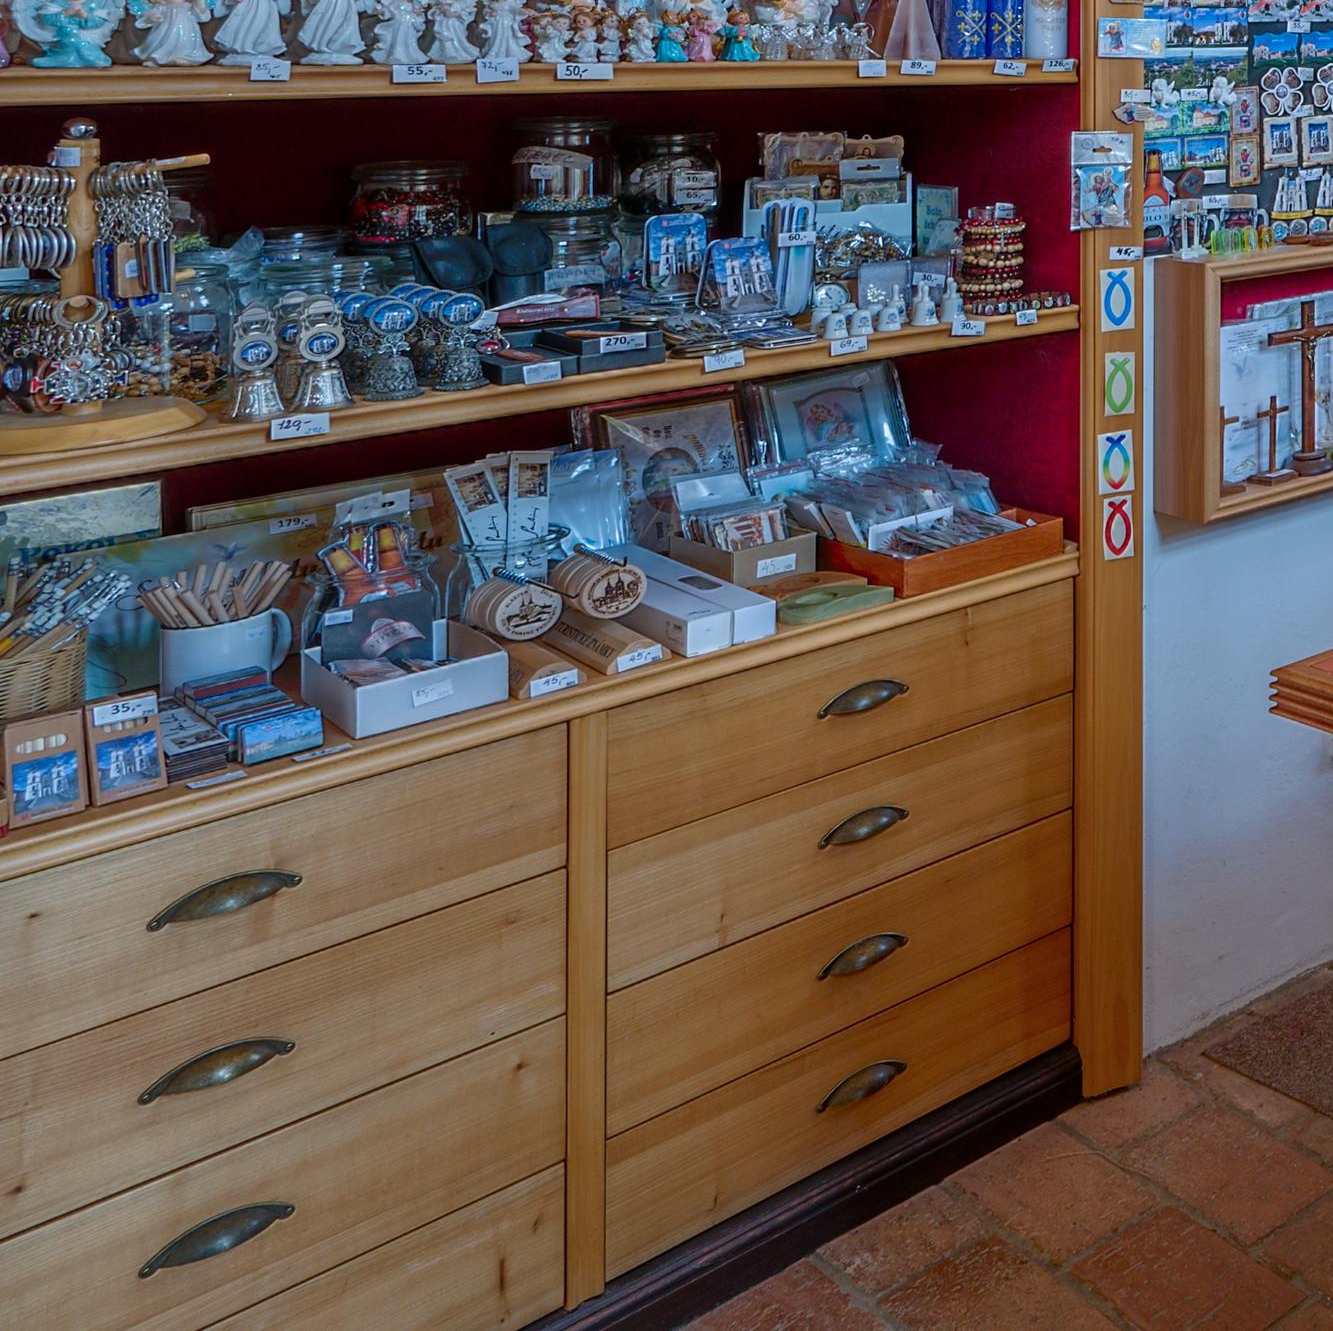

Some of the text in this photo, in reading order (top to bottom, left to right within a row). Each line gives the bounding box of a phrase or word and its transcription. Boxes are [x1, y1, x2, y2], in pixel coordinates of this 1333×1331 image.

[910, 61, 928, 71] 89,-
[1003, 61, 1019, 71] 62,-
[1048, 60, 1069, 69] 126,-
[407, 65, 434, 78] 55,-
[565, 65, 589, 79] 50,-
[686, 191, 705, 200] 65,-
[788, 233, 808, 243] 60,-
[921, 273, 938, 283] 30,-
[605, 335, 635, 347] 270,-
[276, 515, 313, 530] 179,-
[111, 701, 143, 715] 35,-
